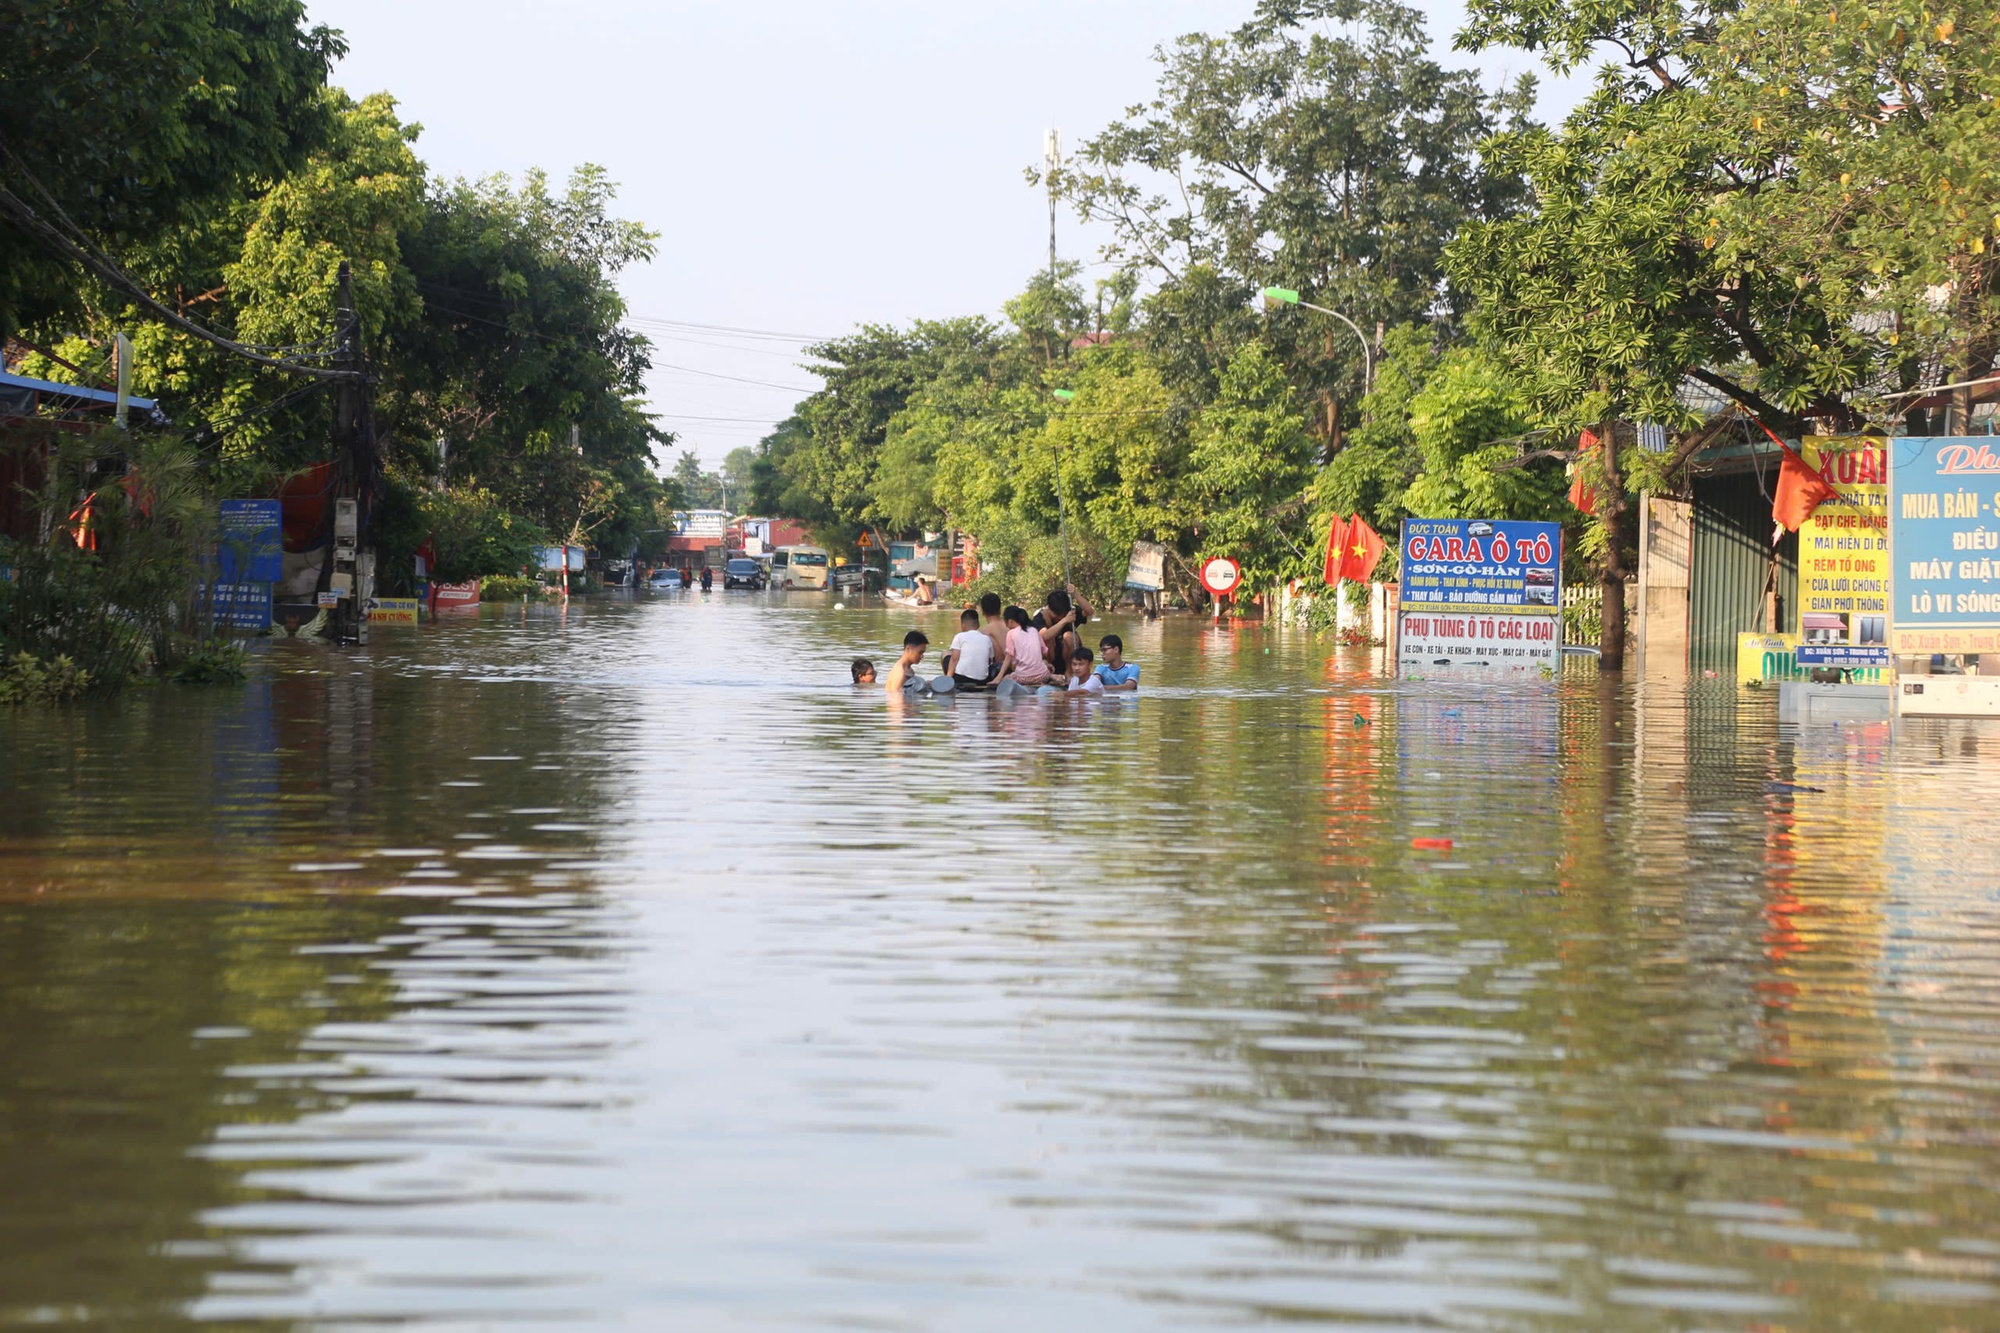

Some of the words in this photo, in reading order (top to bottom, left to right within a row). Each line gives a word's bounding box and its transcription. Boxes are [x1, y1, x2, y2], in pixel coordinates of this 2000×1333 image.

[1936, 444, 2000, 474] Ph
[1902, 493, 1940, 519] MUA
[1943, 487, 1978, 519] BÁN
[1409, 522, 1430, 534] ĐỨC
[1433, 523, 1459, 535] TOÀN
[1814, 514, 1834, 530] BẠT
[1837, 515, 1856, 528] CHE
[1814, 534, 1834, 549] MÁI
[1864, 538, 1873, 550] DI
[1952, 525, 1998, 550] ĐIỀU
[1408, 536, 1484, 563] GARA
[1490, 531, 1510, 564] Ô
[1515, 532, 1552, 565] TÔ
[1854, 560, 1876, 573] ONG
[1910, 557, 1953, 580] MÁY
[1959, 557, 2000, 583] GIẶT
[1411, 590, 1428, 601] THAY
[1506, 589, 1522, 605] MÁY
[1834, 596, 1854, 610] PHƠI
[1911, 590, 1932, 613] LÒ
[1936, 594, 1952, 613] VI
[1956, 590, 2000, 613] SÓNG
[1405, 618, 1430, 641] PHỤ
[1433, 615, 1465, 638] TÙNG
[1468, 616, 1476, 639] Ô
[1480, 616, 1494, 639] TÔ
[1498, 617, 1522, 640] CÁC
[1526, 621, 1554, 645] LOẠI
[1404, 645, 1411, 653] XE
[1412, 645, 1423, 654] CON
[1427, 646, 1434, 654] XE
[1447, 646, 1454, 655] XE
[1968, 633, 1994, 650] Trung
